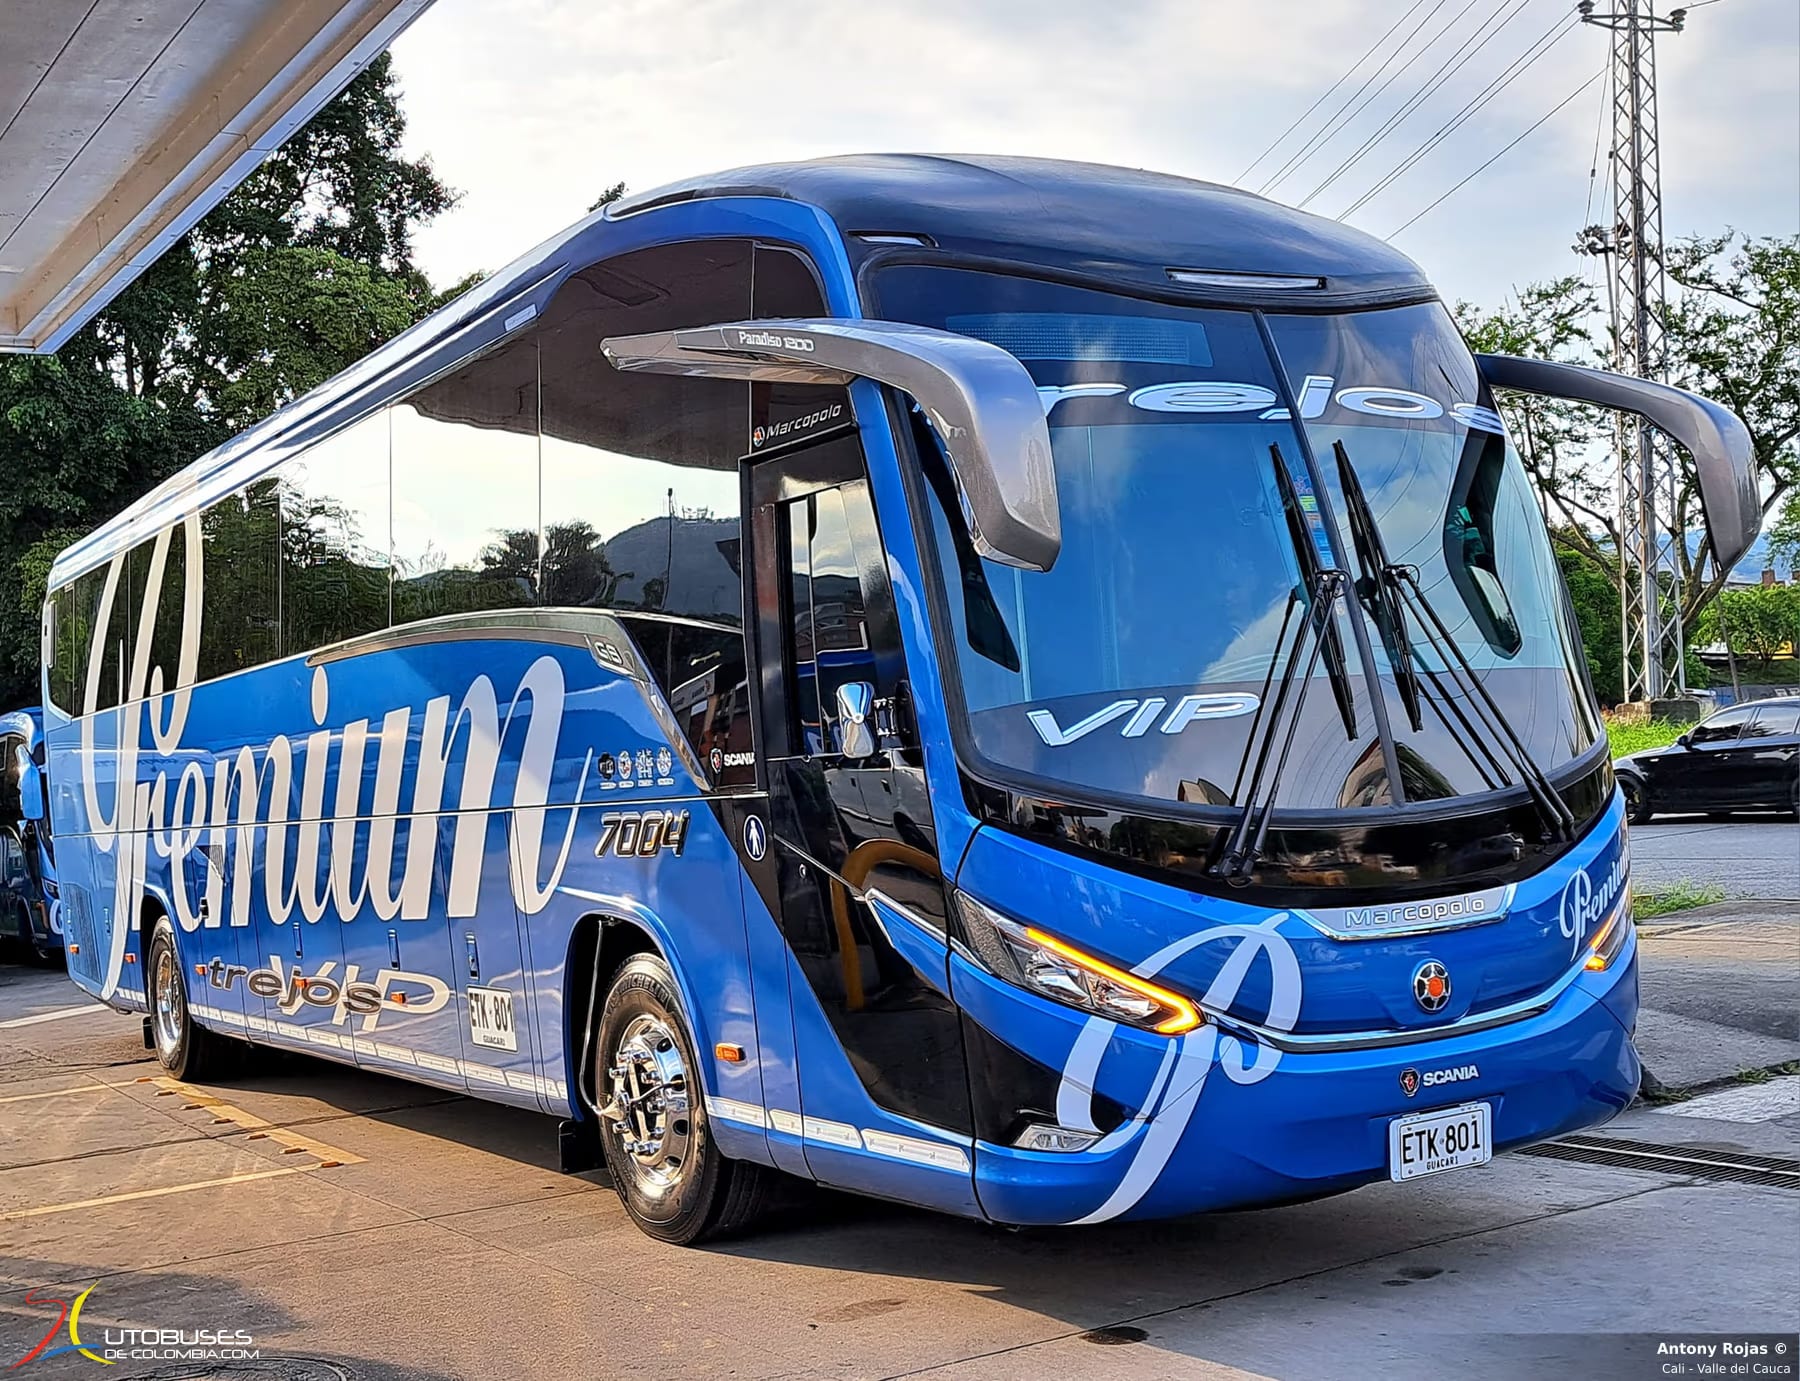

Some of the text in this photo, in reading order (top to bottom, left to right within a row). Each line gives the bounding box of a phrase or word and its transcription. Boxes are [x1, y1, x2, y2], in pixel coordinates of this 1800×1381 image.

[739, 331, 815, 352] Paradiso 1200
[766, 404, 842, 440] Marcopolo
[1036, 375, 1507, 436] rejos
[1026, 692, 1261, 747] VIP
[82, 511, 593, 1001] Premium
[594, 809, 691, 858] 7004
[1345, 895, 1485, 928] Marcopolo
[1558, 827, 1630, 963] Premiu
[1423, 1065, 1479, 1087] SCANIA
[1402, 1119, 1481, 1165] ETK 801
[1426, 1155, 1459, 1171] GUACARI
